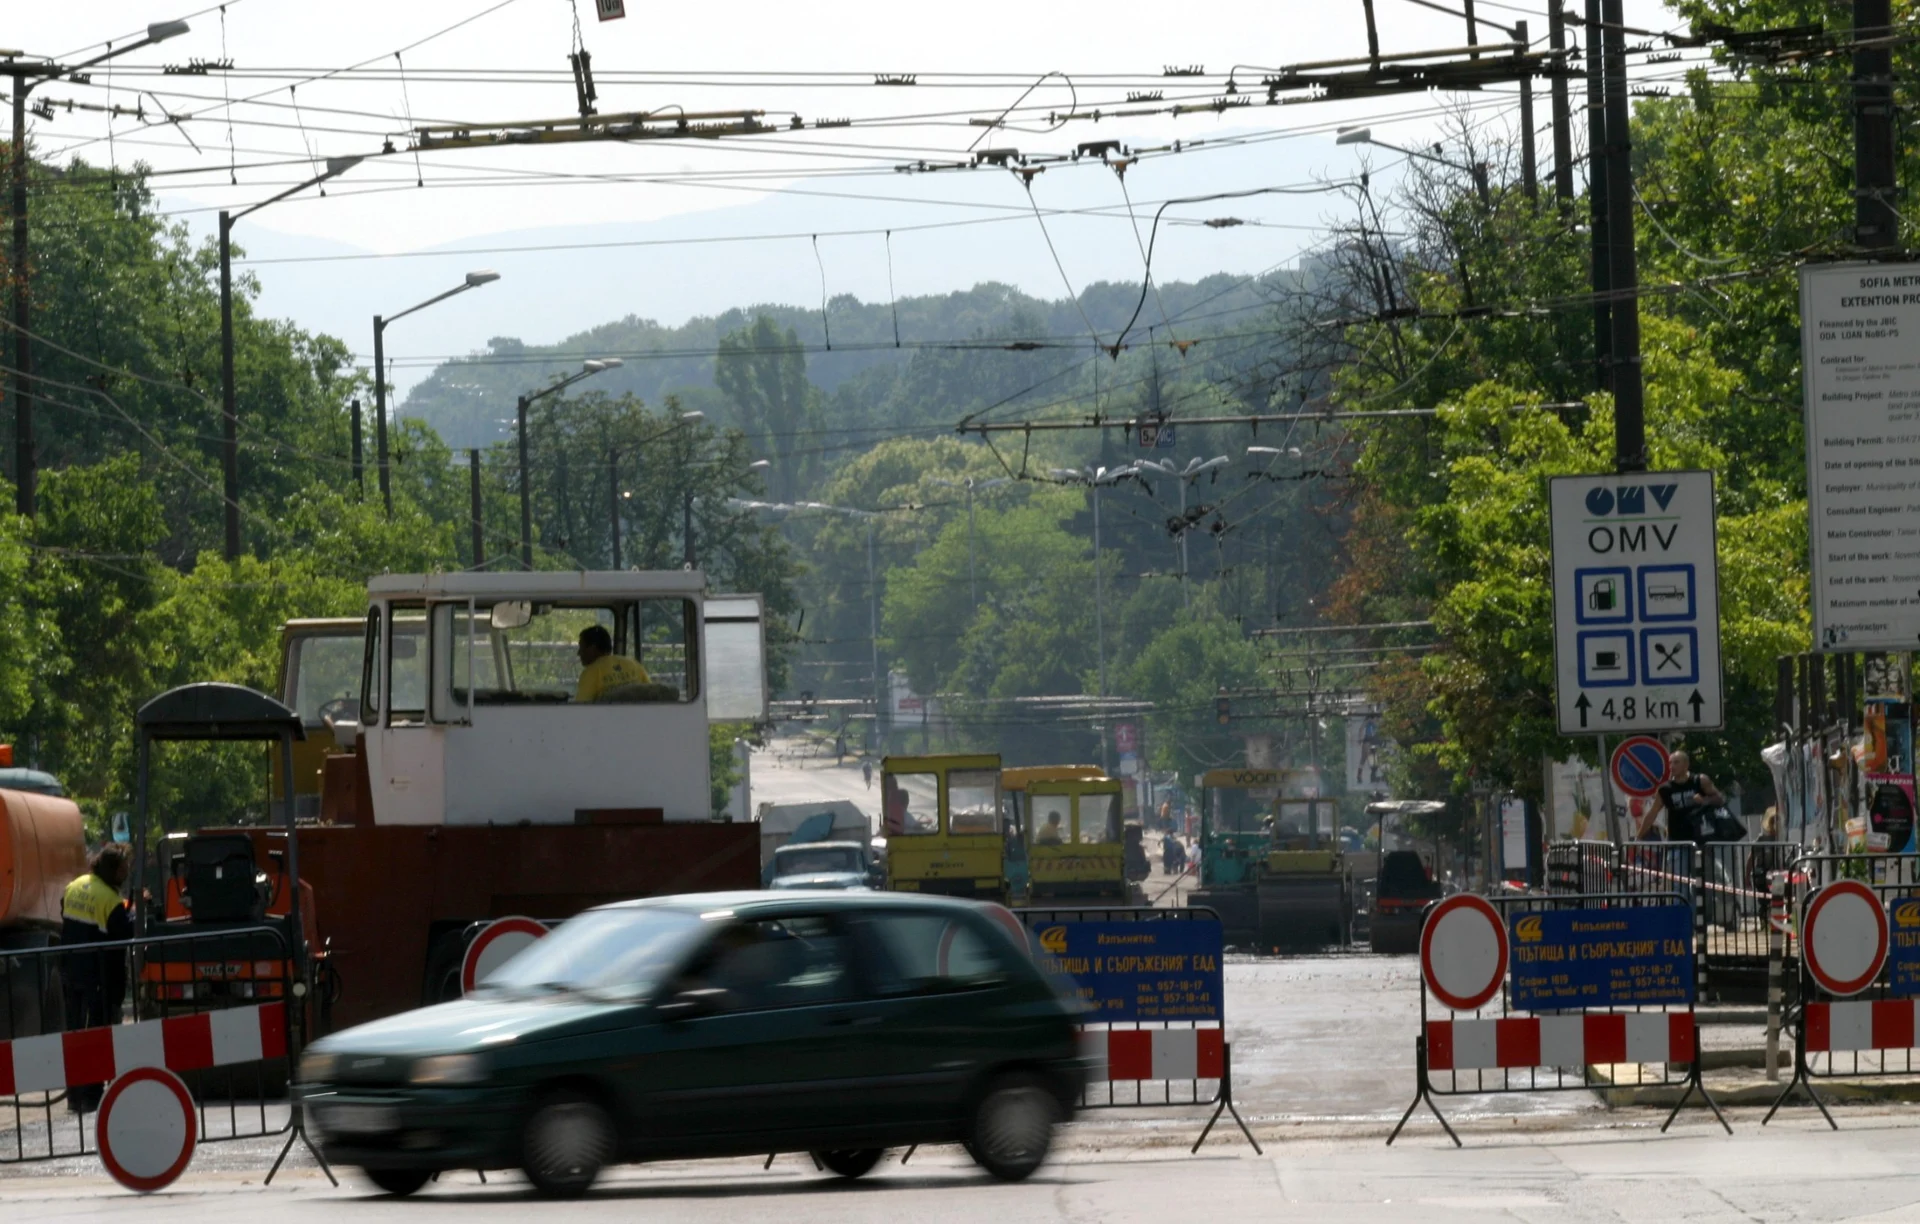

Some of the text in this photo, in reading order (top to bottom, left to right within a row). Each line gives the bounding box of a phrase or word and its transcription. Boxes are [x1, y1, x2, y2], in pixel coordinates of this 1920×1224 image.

[1860, 277, 1889, 288] SOFIA
[1841, 295, 1900, 307] EXTENTION
[1819, 320, 1853, 329] Financed
[1855, 320, 1864, 329] by
[1866, 318, 1878, 327] the
[1841, 330, 1862, 340] LOAN
[1821, 356, 1852, 365] Contract
[1822, 391, 1853, 402] Building
[1855, 390, 1883, 401] Project:
[1824, 437, 1855, 447] Building
[1857, 436, 1884, 446] Permit:
[1825, 460, 1842, 470] Date
[1844, 460, 1852, 469] of
[1854, 460, 1883, 470] opening
[1885, 459, 1894, 468] of
[1895, 458, 1907, 467] the
[1827, 507, 1866, 517] Consultant
[1588, 523, 1678, 554] OMV
[1827, 530, 1847, 539] Main
[1829, 553, 1847, 562] Start
[1849, 553, 1856, 561] of
[1857, 552, 1870, 561] the
[1829, 577, 1845, 585] End
[1847, 576, 1854, 584] of
[1855, 576, 1867, 584] the
[1830, 600, 1867, 609] Maximum
[1869, 598, 1898, 608] number
[1900, 597, 1907, 606] of
[1601, 696, 1679, 723] 4,8 km
[1569, 944, 1577, 961] И
[1663, 939, 1686, 956] ЕАД
[1095, 956, 1102, 973] И
[1193, 954, 1216, 972] ЕАД
